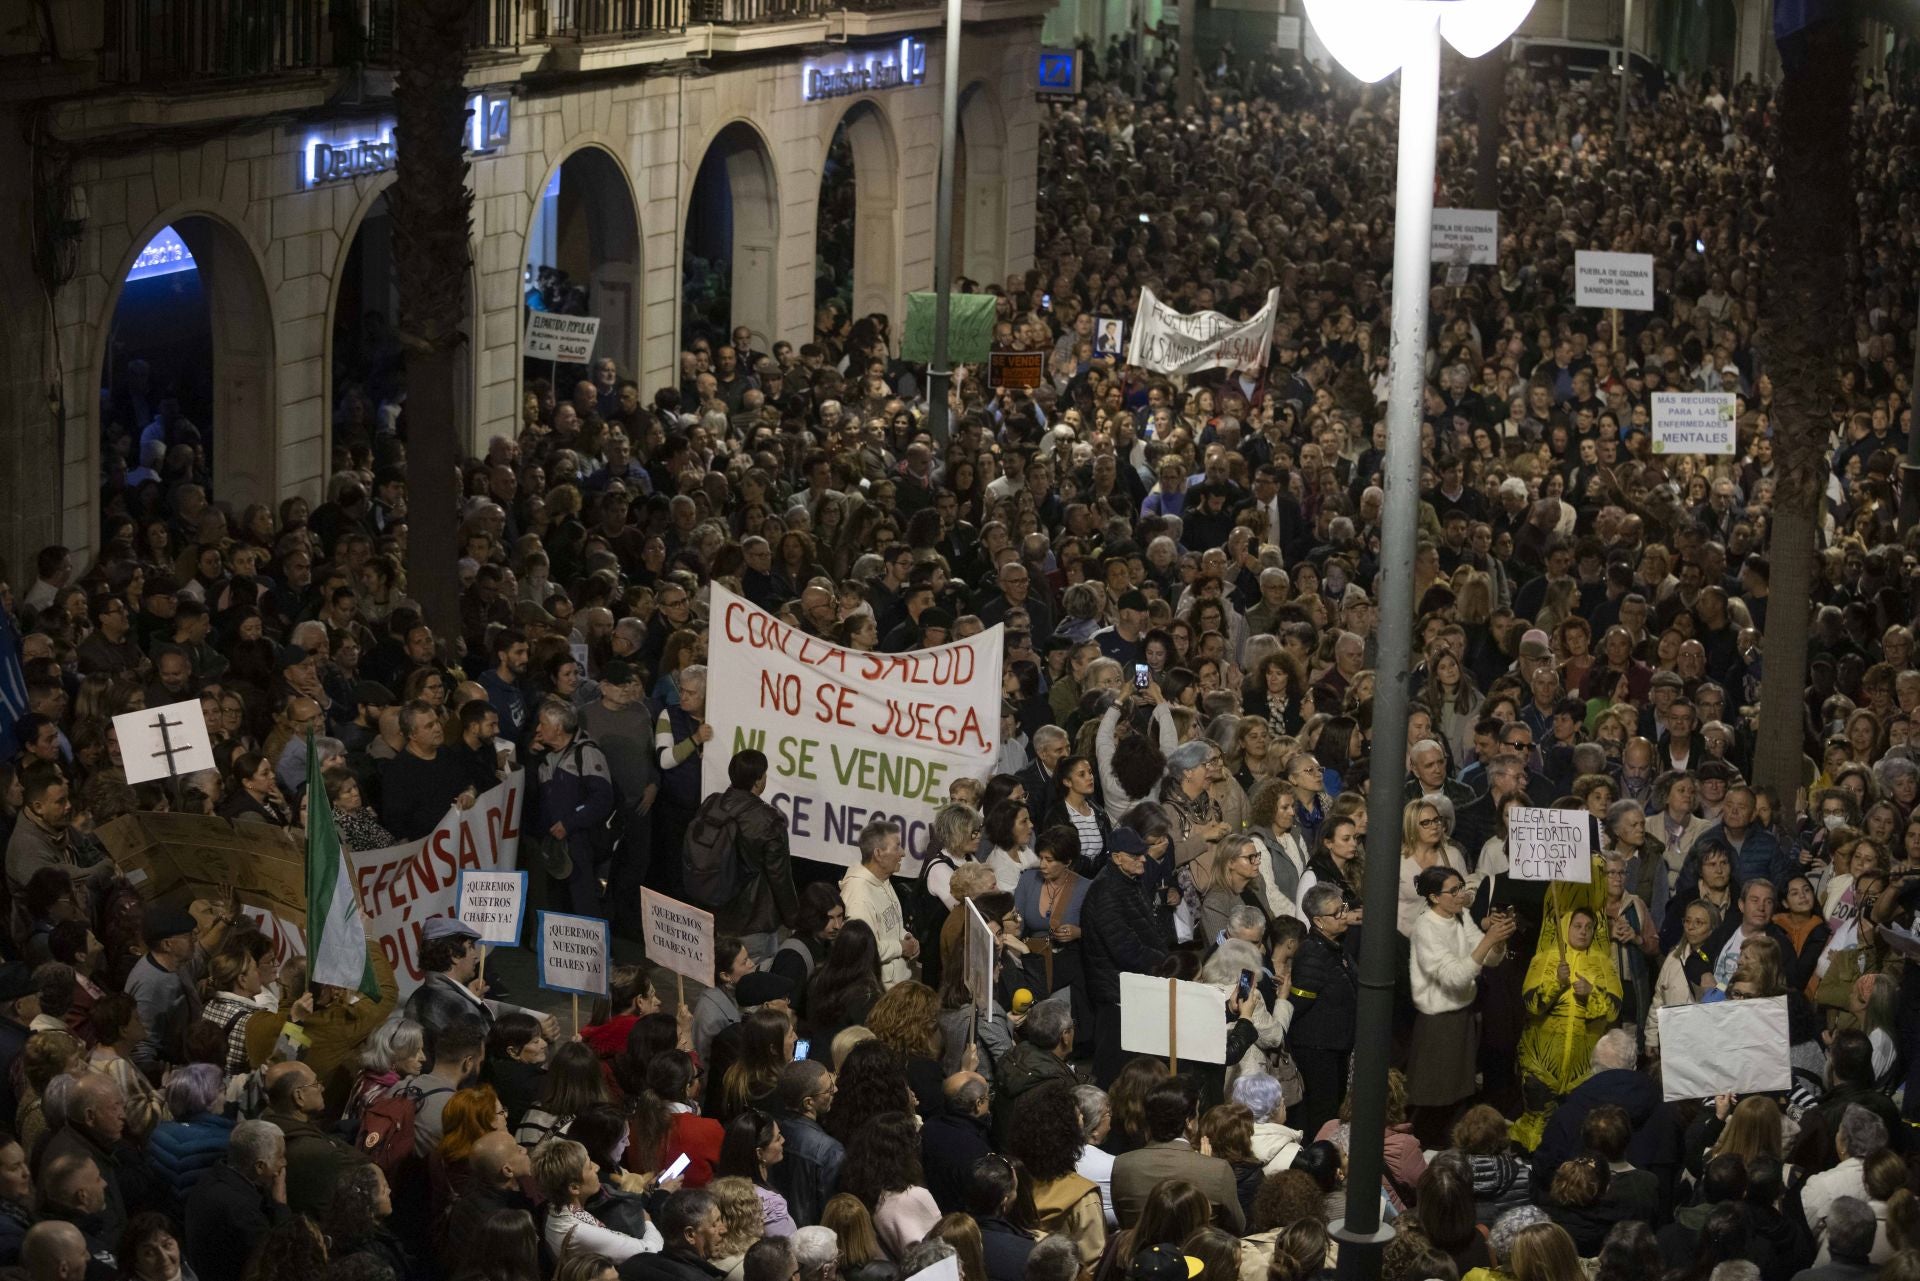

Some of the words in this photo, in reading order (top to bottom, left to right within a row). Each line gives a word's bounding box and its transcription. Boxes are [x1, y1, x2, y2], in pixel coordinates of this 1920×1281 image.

[807, 63, 871, 100] Deutsche
[872, 60, 901, 90] Ban
[315, 139, 396, 183] Deutsc
[1444, 233, 1459, 241] POR
[1453, 224, 1463, 233] DE
[1579, 267, 1607, 276] PUEBLA
[1608, 268, 1617, 276] DE
[1583, 286, 1614, 295] SANIDAD
[1614, 278, 1630, 286] UNA
[538, 342, 551, 351] LA
[558, 344, 586, 355] SALUD
[992, 355, 1005, 366] SE
[1008, 355, 1041, 367] VENDE
[1681, 396, 1728, 405] RECURSOS
[1668, 407, 1692, 416] PARA
[1699, 408, 1716, 416] LAS
[1657, 420, 1728, 429] ENFERMEDADES
[1662, 432, 1728, 443] MENTALES
[725, 602, 792, 655] CON
[799, 637, 845, 672] LA
[861, 644, 975, 686] SALUD
[760, 669, 801, 716] NO
[815, 683, 858, 727] SE
[872, 699, 993, 753] JUEGA,
[776, 736, 820, 780] SE
[830, 743, 950, 810] VENDE,
[771, 792, 813, 838] SE
[1510, 807, 1546, 823] LLEGA
[1548, 809, 1569, 825] EL
[1510, 826, 1582, 843] METEORITO
[1516, 842, 1522, 858] Y
[1529, 842, 1546, 860] YO
[1548, 843, 1577, 859] SIN
[358, 820, 481, 919] EFENSA
[1514, 858, 1567, 878] "CITA"
[466, 880, 515, 893] ¡QUEREMOS
[468, 896, 511, 908] NUESTROS
[463, 911, 496, 923] CHARES
[498, 913, 513, 924] YA!
[651, 904, 702, 932] ¡QUEREMOS
[549, 924, 600, 941] ¡QUEREMOS
[655, 920, 700, 946] NUESTROS
[552, 940, 598, 957] NUESTROS
[652, 934, 686, 955] CHARES
[687, 947, 703, 962] YA!
[549, 956, 584, 971] CHARES
[586, 961, 601, 974] YA!
